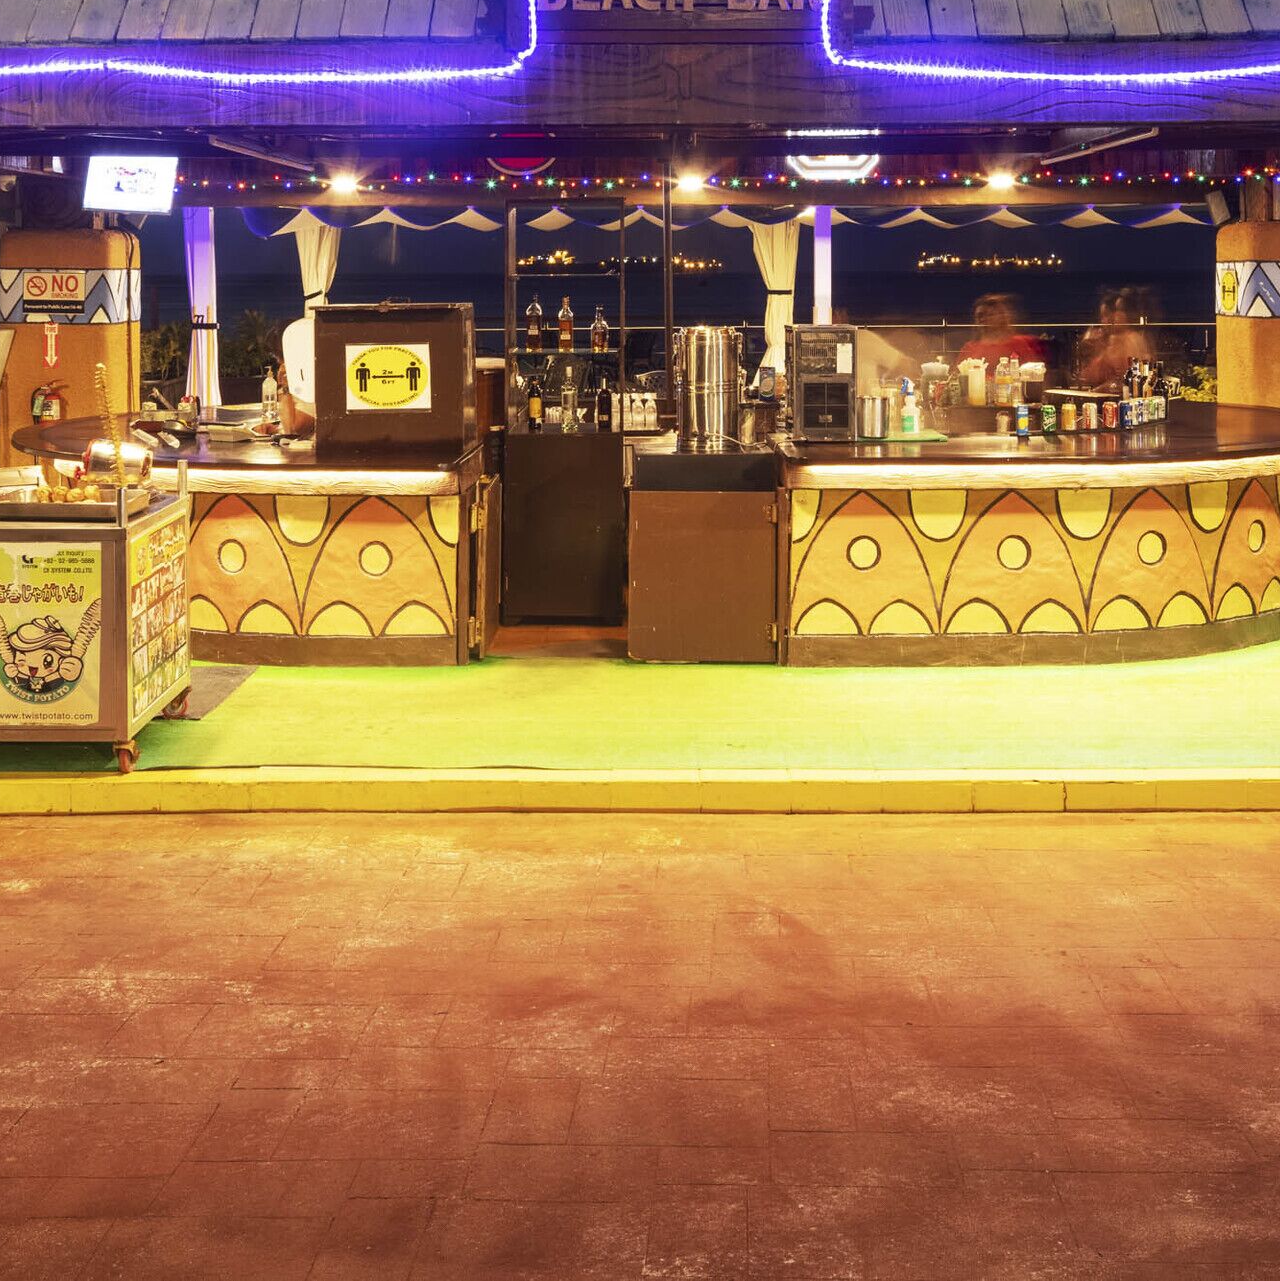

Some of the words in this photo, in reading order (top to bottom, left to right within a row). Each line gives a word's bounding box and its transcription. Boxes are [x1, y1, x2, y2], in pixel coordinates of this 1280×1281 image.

[51, 274, 79, 292] NO
[5, 681, 33, 700] TWIST
[34, 685, 70, 702] POTATO
